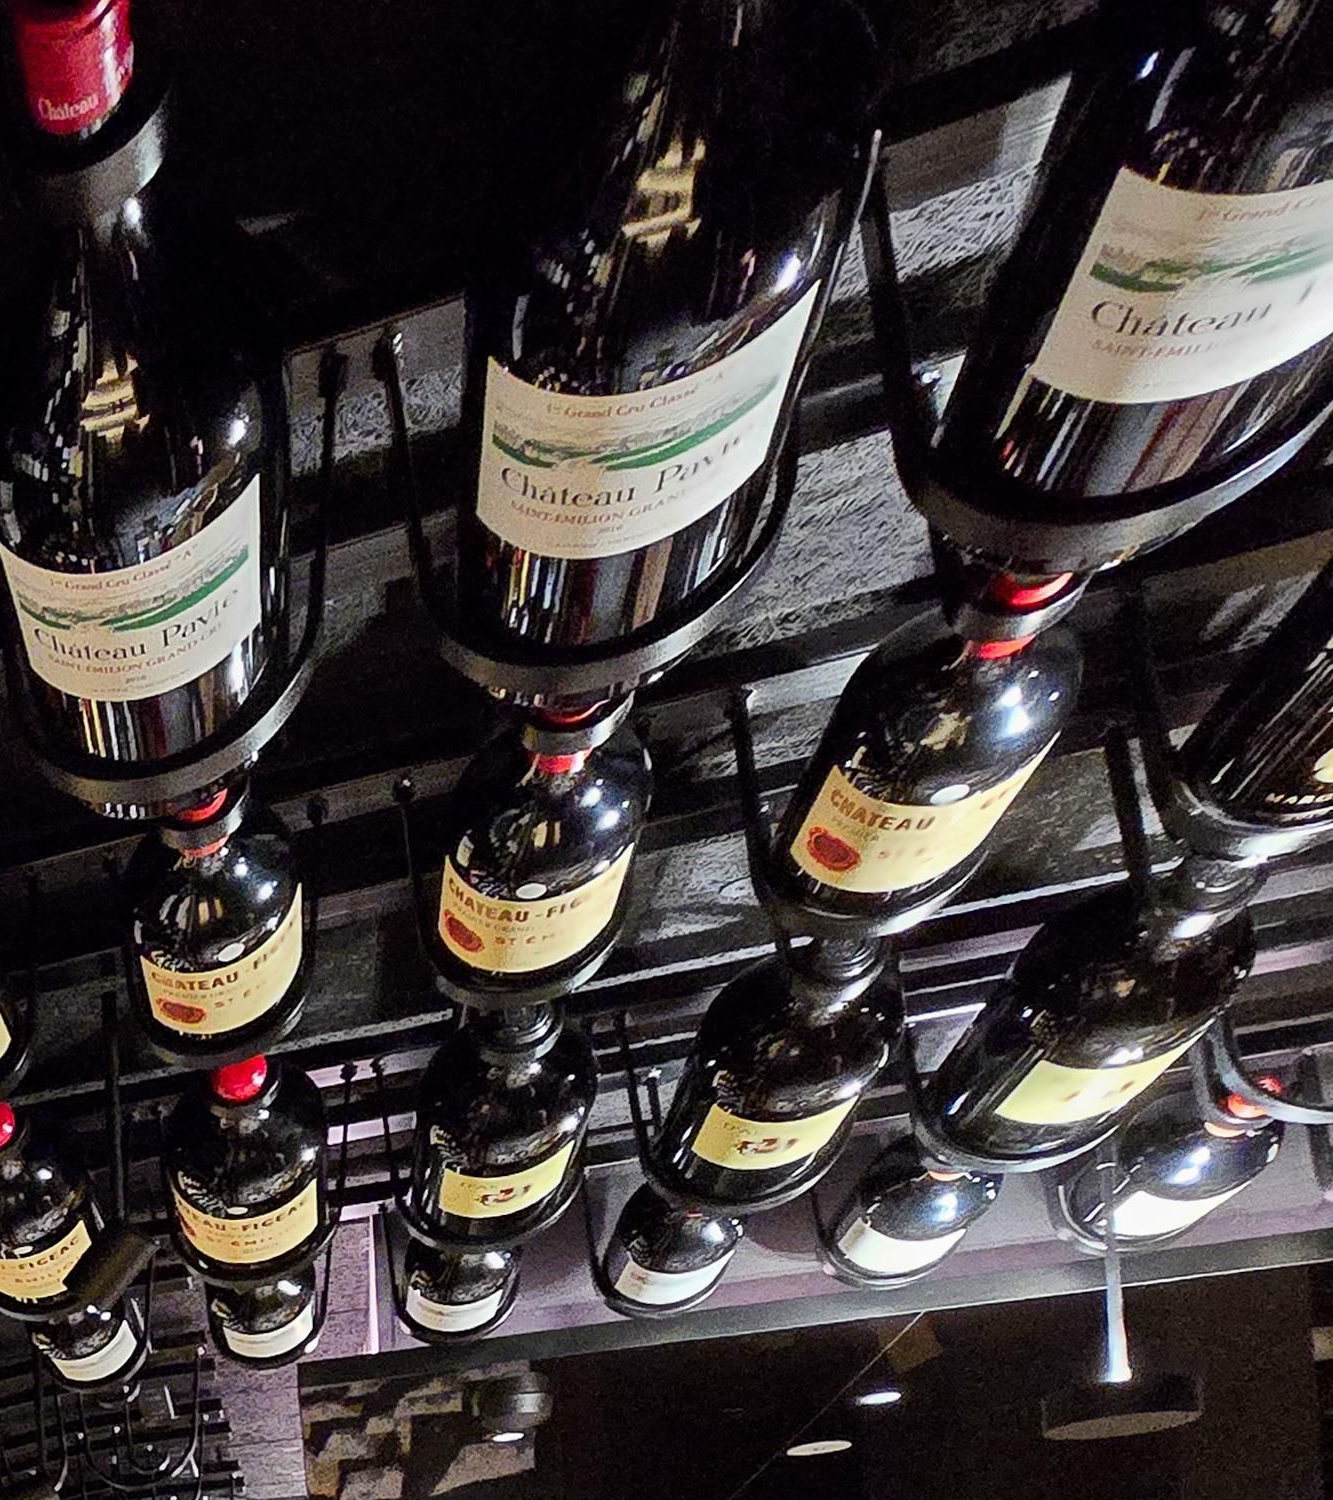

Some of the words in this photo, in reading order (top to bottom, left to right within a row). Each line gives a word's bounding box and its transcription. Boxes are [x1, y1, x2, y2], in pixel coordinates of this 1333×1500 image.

[501, 466, 635, 507] Château
[34, 627, 146, 660] Château
[161, 589, 238, 647] Pavie
[146, 640, 198, 668] GRAND
